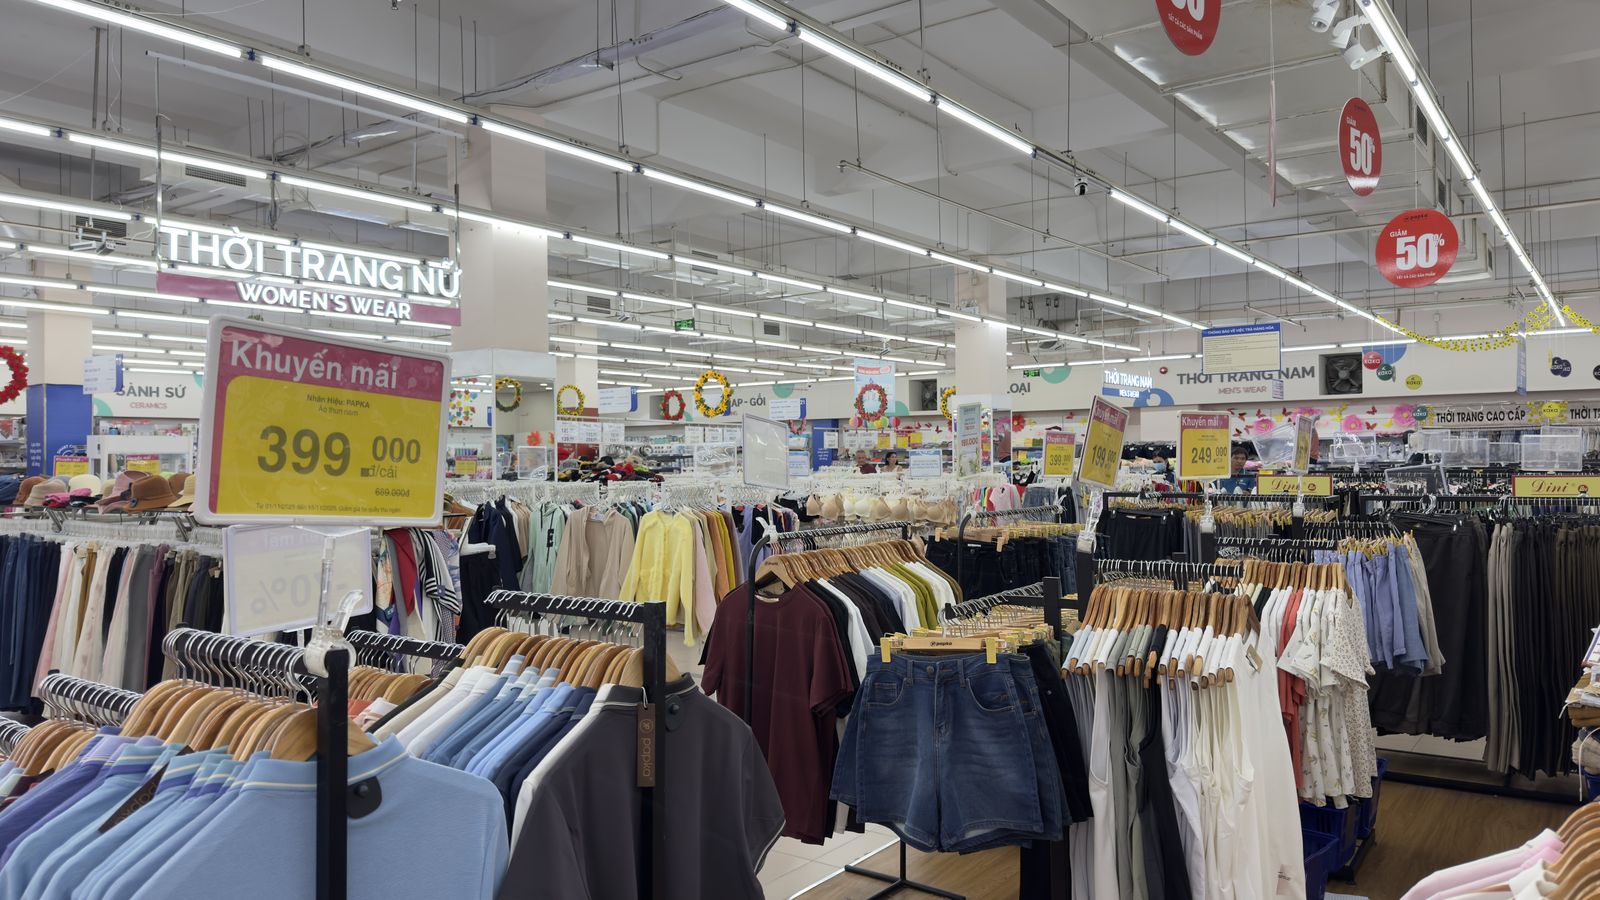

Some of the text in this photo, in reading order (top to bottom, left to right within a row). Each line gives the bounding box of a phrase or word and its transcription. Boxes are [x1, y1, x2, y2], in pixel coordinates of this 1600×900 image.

[1389, 229, 1408, 238] GIẢM
[1396, 233, 1445, 271] 50%
[160, 226, 462, 298] THỜI TRANG NỮ
[236, 283, 412, 320] WOMEN'S WEAR
[230, 339, 398, 389] Khuyến mãi
[1120, 372, 1139, 387] TRANG
[1278, 365, 1315, 379] NAM
[165, 384, 188, 398] SỨ
[1242, 385, 1267, 394] WEAR
[129, 401, 167, 410] CERAMICS
[346, 399, 370, 409] PAPKA
[1436, 405, 1526, 423] THỜI TRANG CAO CẤP
[1570, 406, 1592, 420] THỜI
[257, 425, 421, 477] 399 000
[1092, 444, 1106, 469] 199
[1191, 446, 1228, 464] 249 000
[1271, 478, 1300, 490] Din
[1531, 479, 1569, 493] Dini
[640, 737, 653, 777] papka
